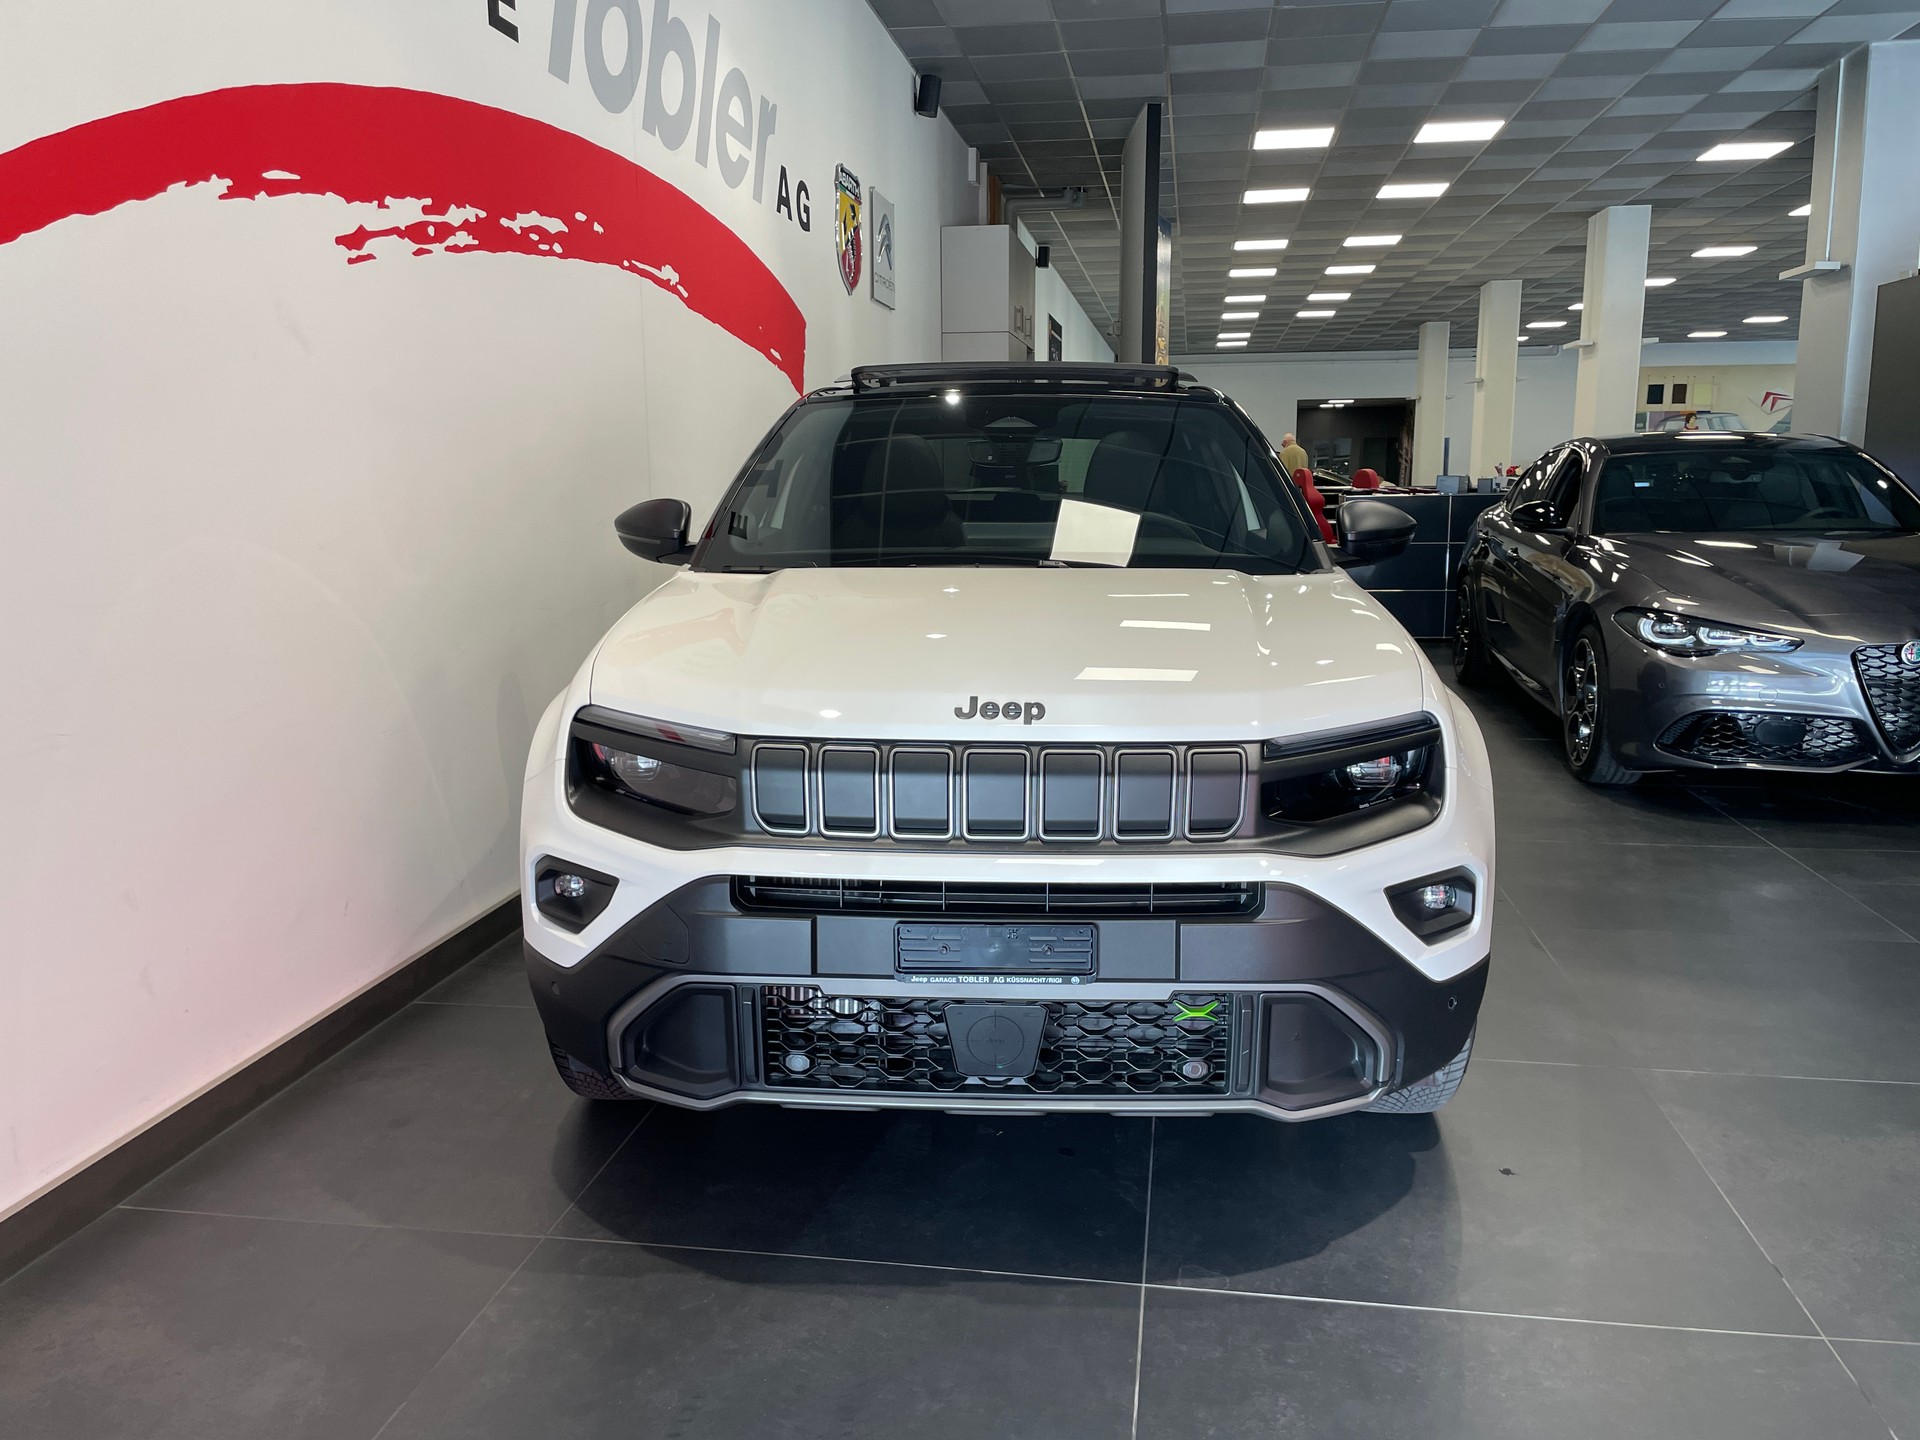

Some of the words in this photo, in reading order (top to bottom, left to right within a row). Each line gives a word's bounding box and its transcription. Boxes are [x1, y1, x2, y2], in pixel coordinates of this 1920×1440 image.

[776, 165, 811, 232] AG
[839, 171, 860, 199] ABARTH
[953, 696, 1046, 725] Jeep
[911, 975, 928, 983] Jeep
[1006, 976, 1063, 984] KÜSSNACHT/RIGI
